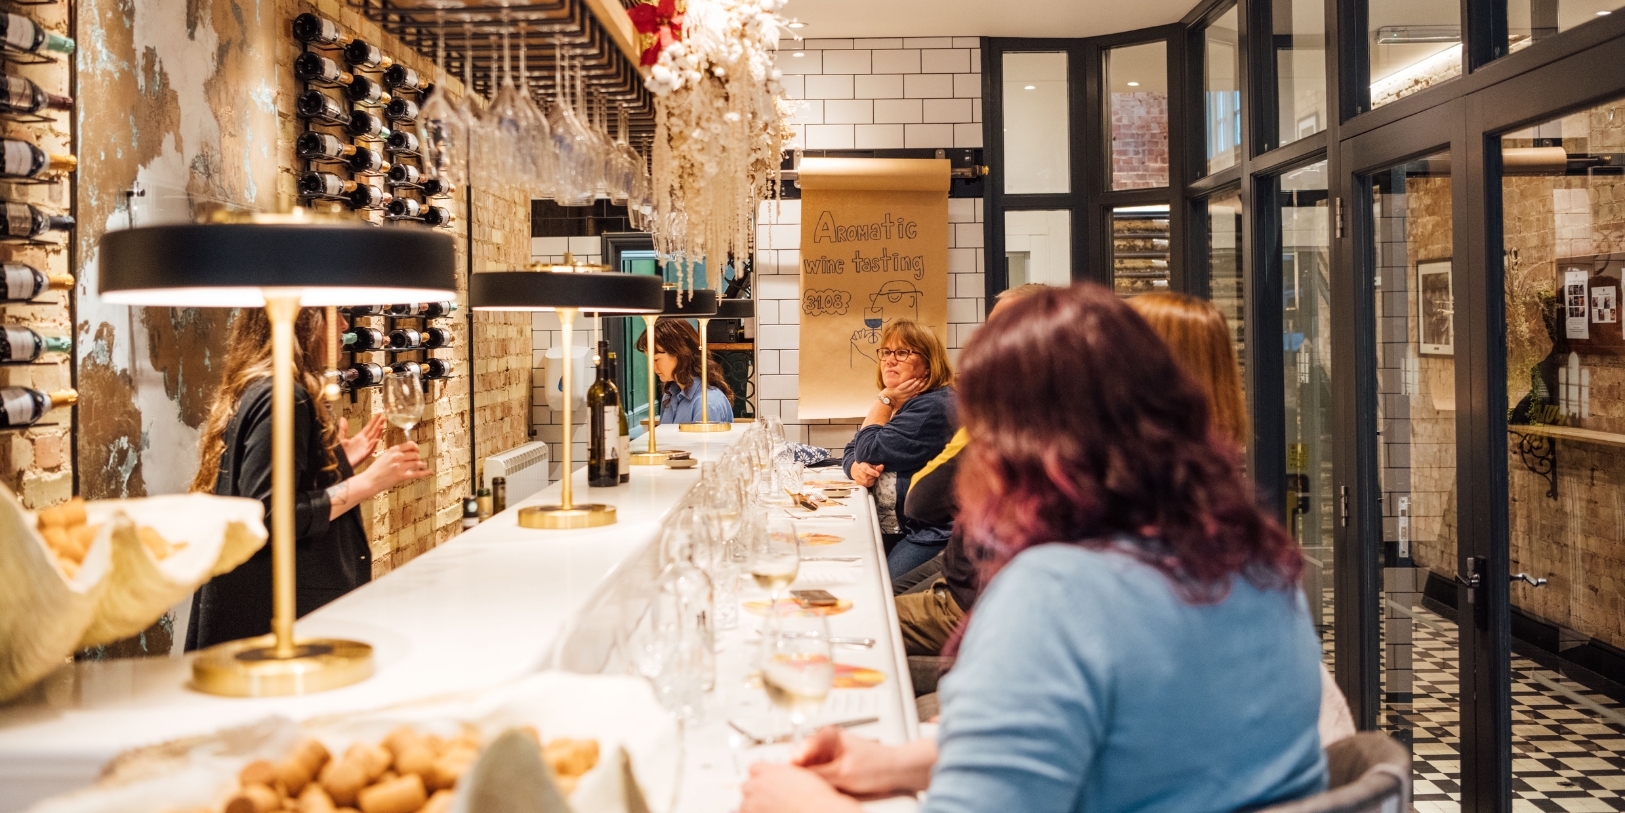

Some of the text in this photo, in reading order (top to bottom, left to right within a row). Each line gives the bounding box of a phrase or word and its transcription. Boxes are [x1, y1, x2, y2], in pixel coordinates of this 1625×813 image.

[803, 248, 925, 280] wine tasting
[806, 294, 843, 310] 31.08
